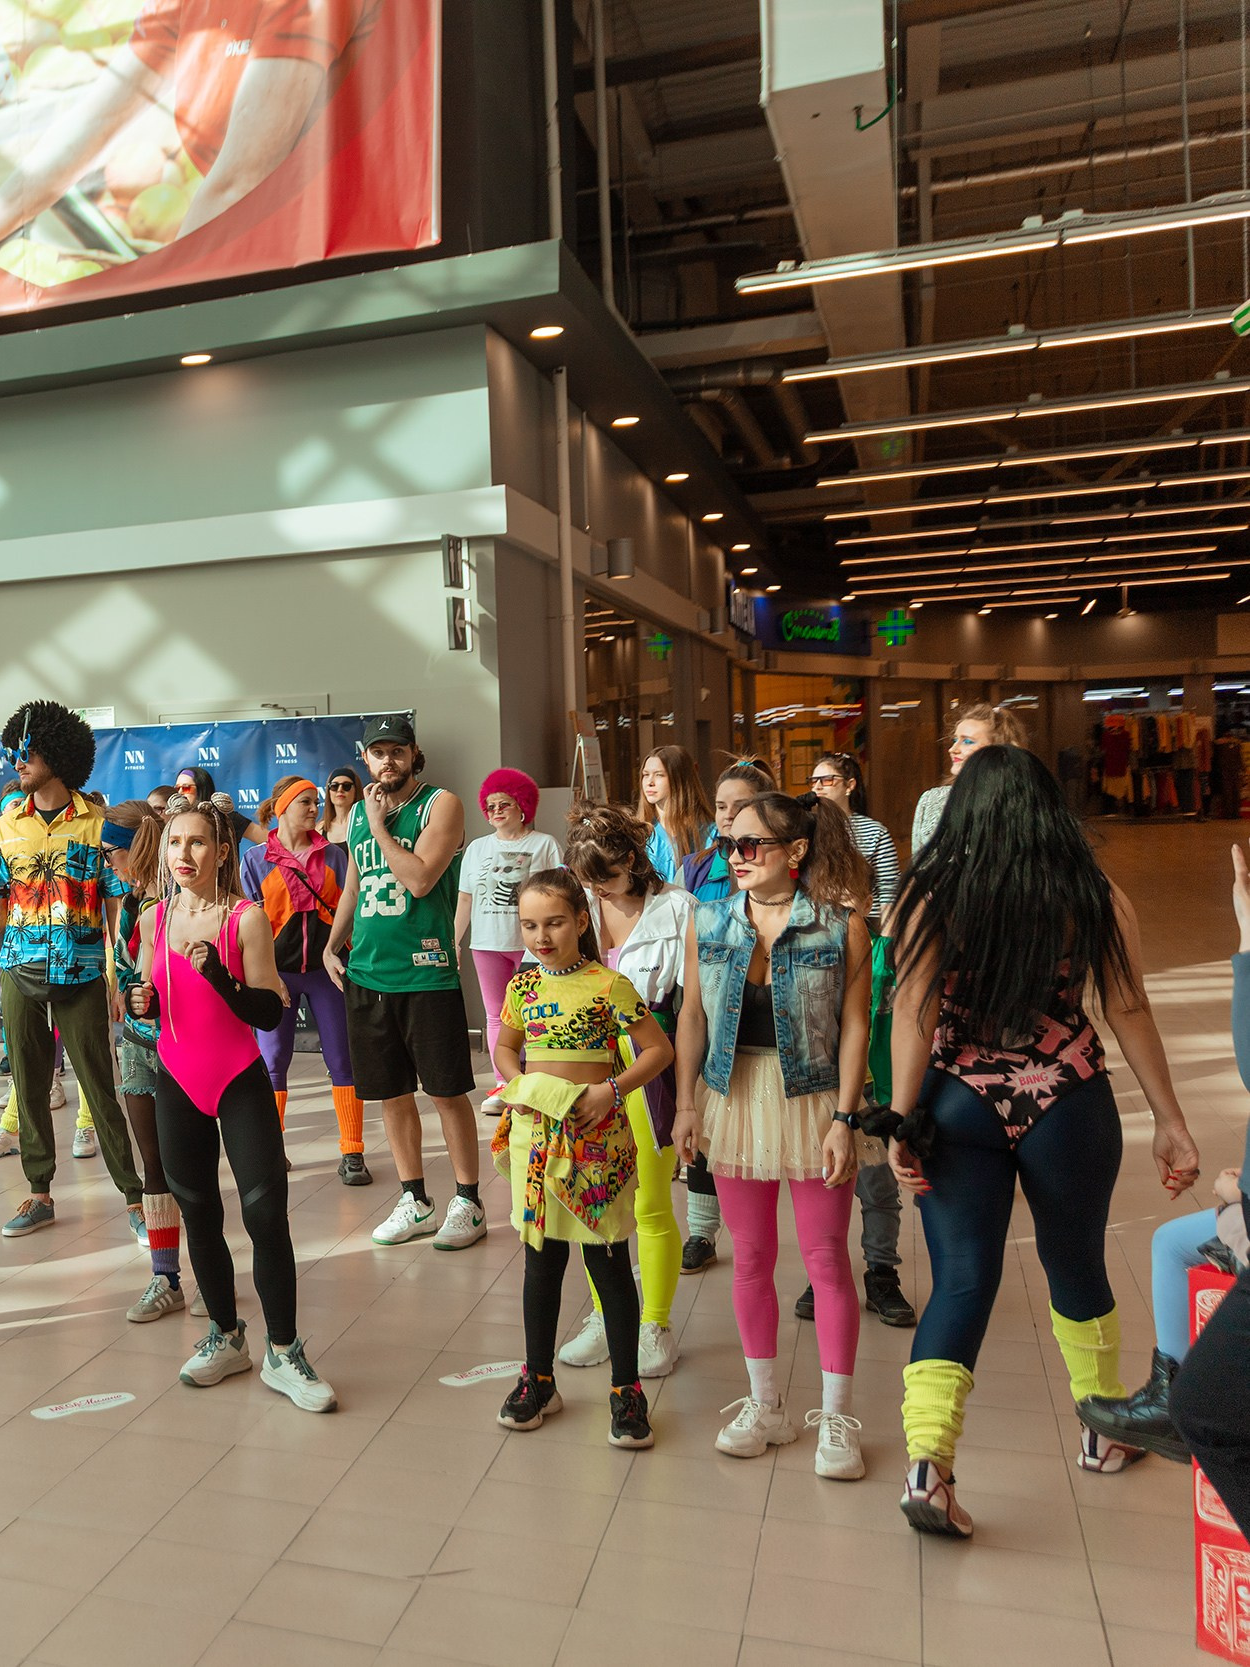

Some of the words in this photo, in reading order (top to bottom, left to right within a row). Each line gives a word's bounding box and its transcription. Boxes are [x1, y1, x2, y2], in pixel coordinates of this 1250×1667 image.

[124, 750, 145, 764] NN
[198, 747, 220, 760] NN
[275, 743, 297, 757] NN
[238, 789, 260, 802] NN
[359, 873, 406, 917] 33
[521, 1002, 564, 1023] COOL
[1018, 1071, 1049, 1087] BANG
